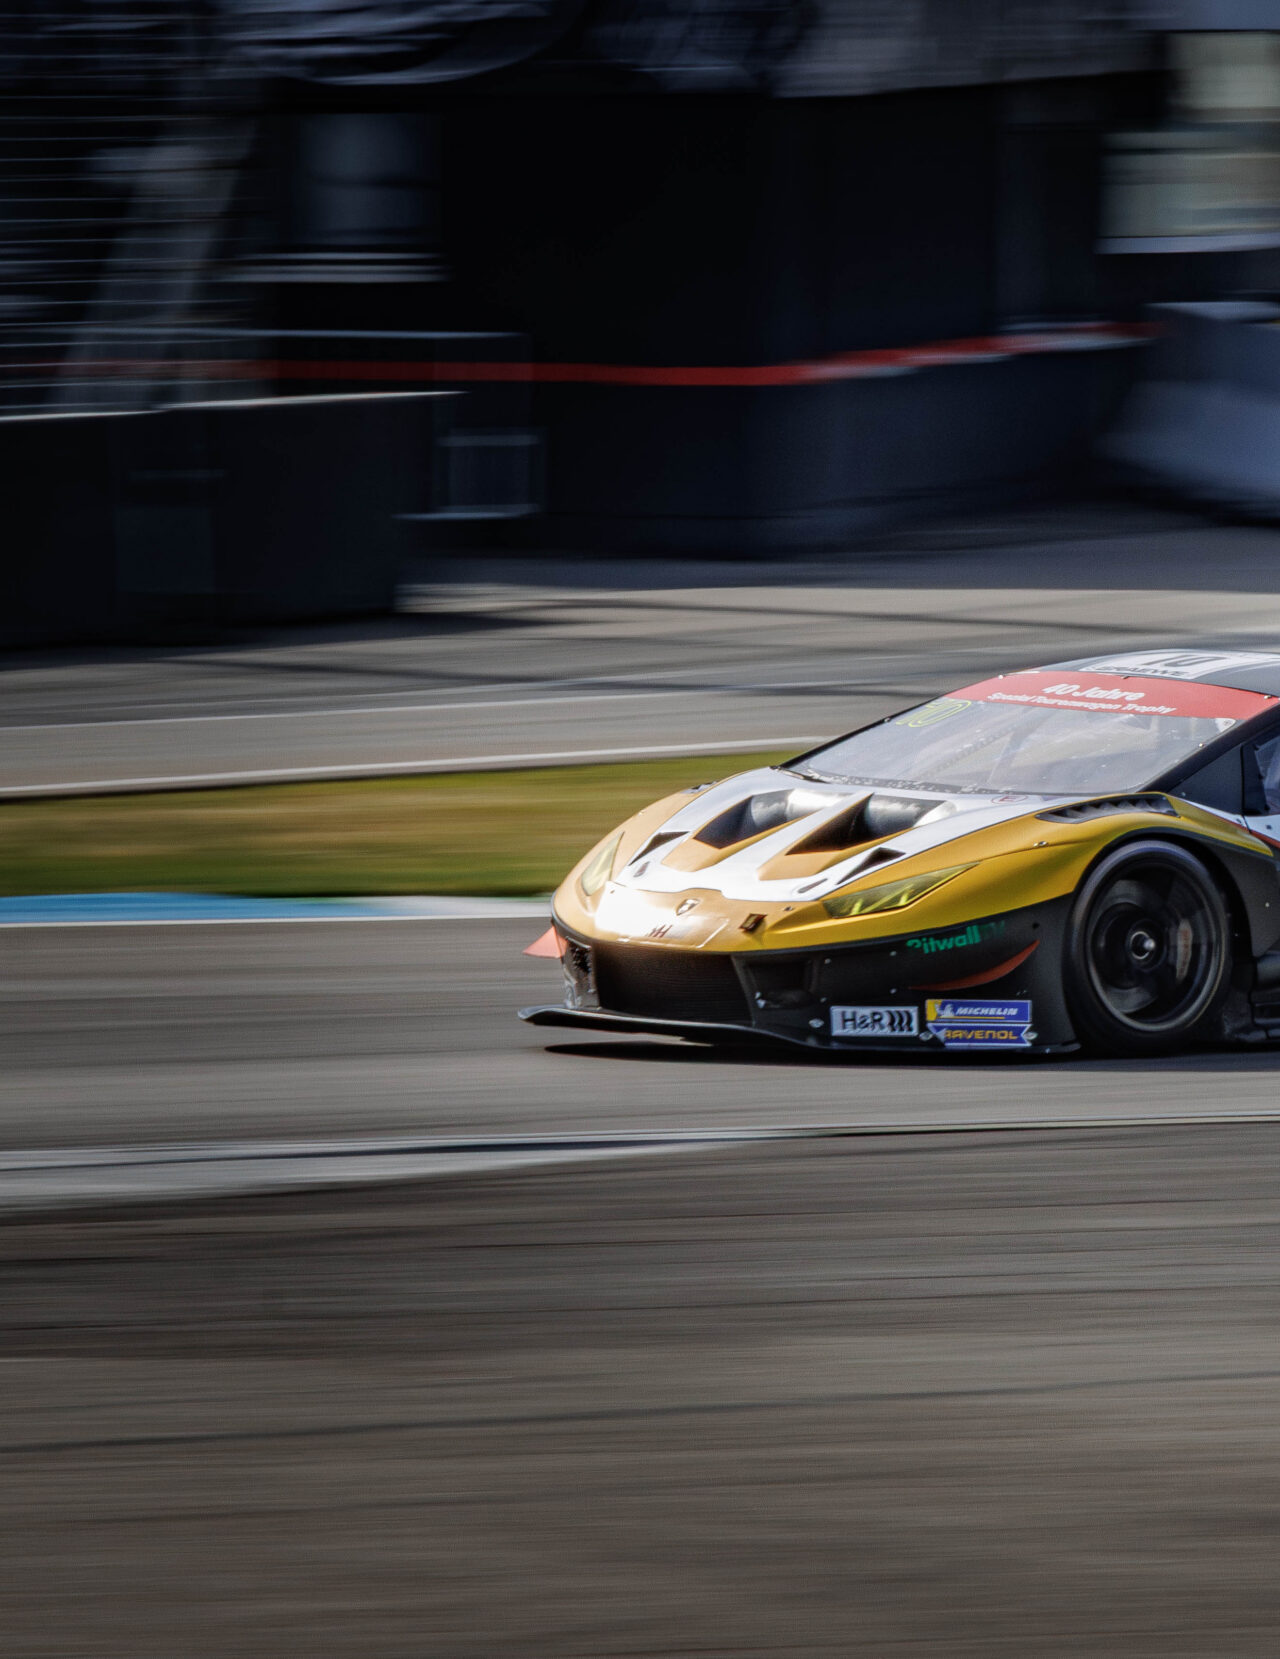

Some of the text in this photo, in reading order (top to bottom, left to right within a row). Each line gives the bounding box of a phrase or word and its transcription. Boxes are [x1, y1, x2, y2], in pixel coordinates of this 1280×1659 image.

[1041, 683, 1146, 701] 40 Jahre
[1033, 696, 1122, 710] Tourenwagen
[1120, 703, 1178, 714] Trophy
[955, 1006, 1018, 1016] MICHELIN
[841, 1011, 889, 1031] H&R
[945, 1029, 1018, 1040] RAVENOL
